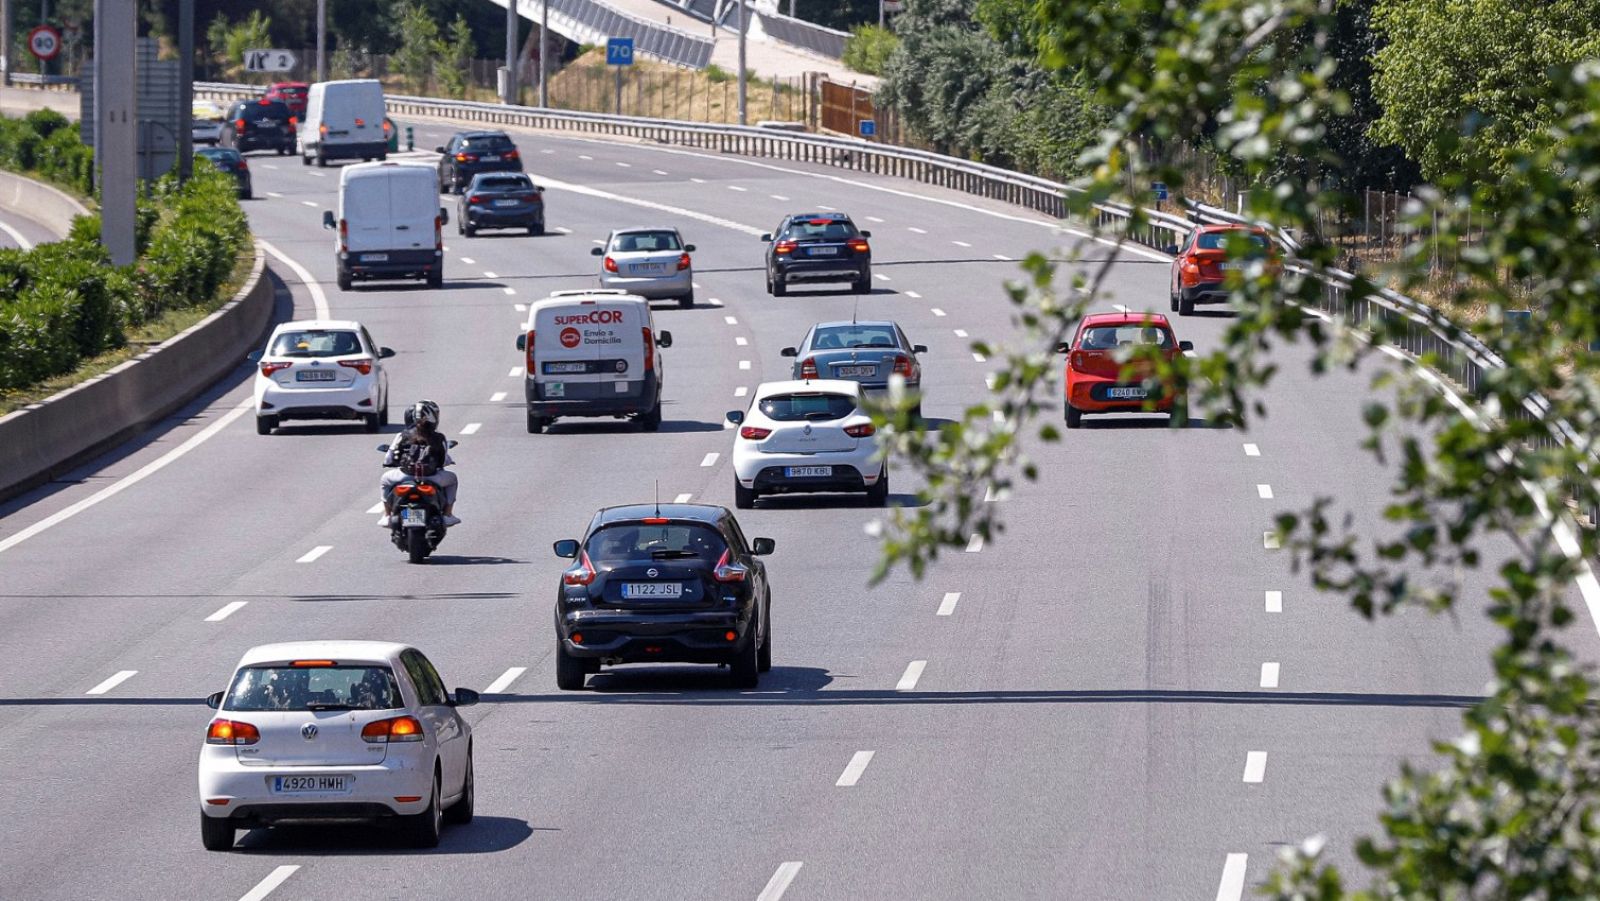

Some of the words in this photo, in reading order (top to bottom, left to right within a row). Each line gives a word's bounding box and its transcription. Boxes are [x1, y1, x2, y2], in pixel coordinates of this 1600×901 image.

[609, 45, 631, 58] 70
[278, 55, 287, 67] 2
[554, 311, 622, 325] SUPERCOR
[583, 336, 622, 345] Domicilio
[630, 584, 656, 595] 1122
[659, 584, 679, 595] JSL
[283, 777, 315, 790] 4920
[318, 777, 344, 790] HMH
